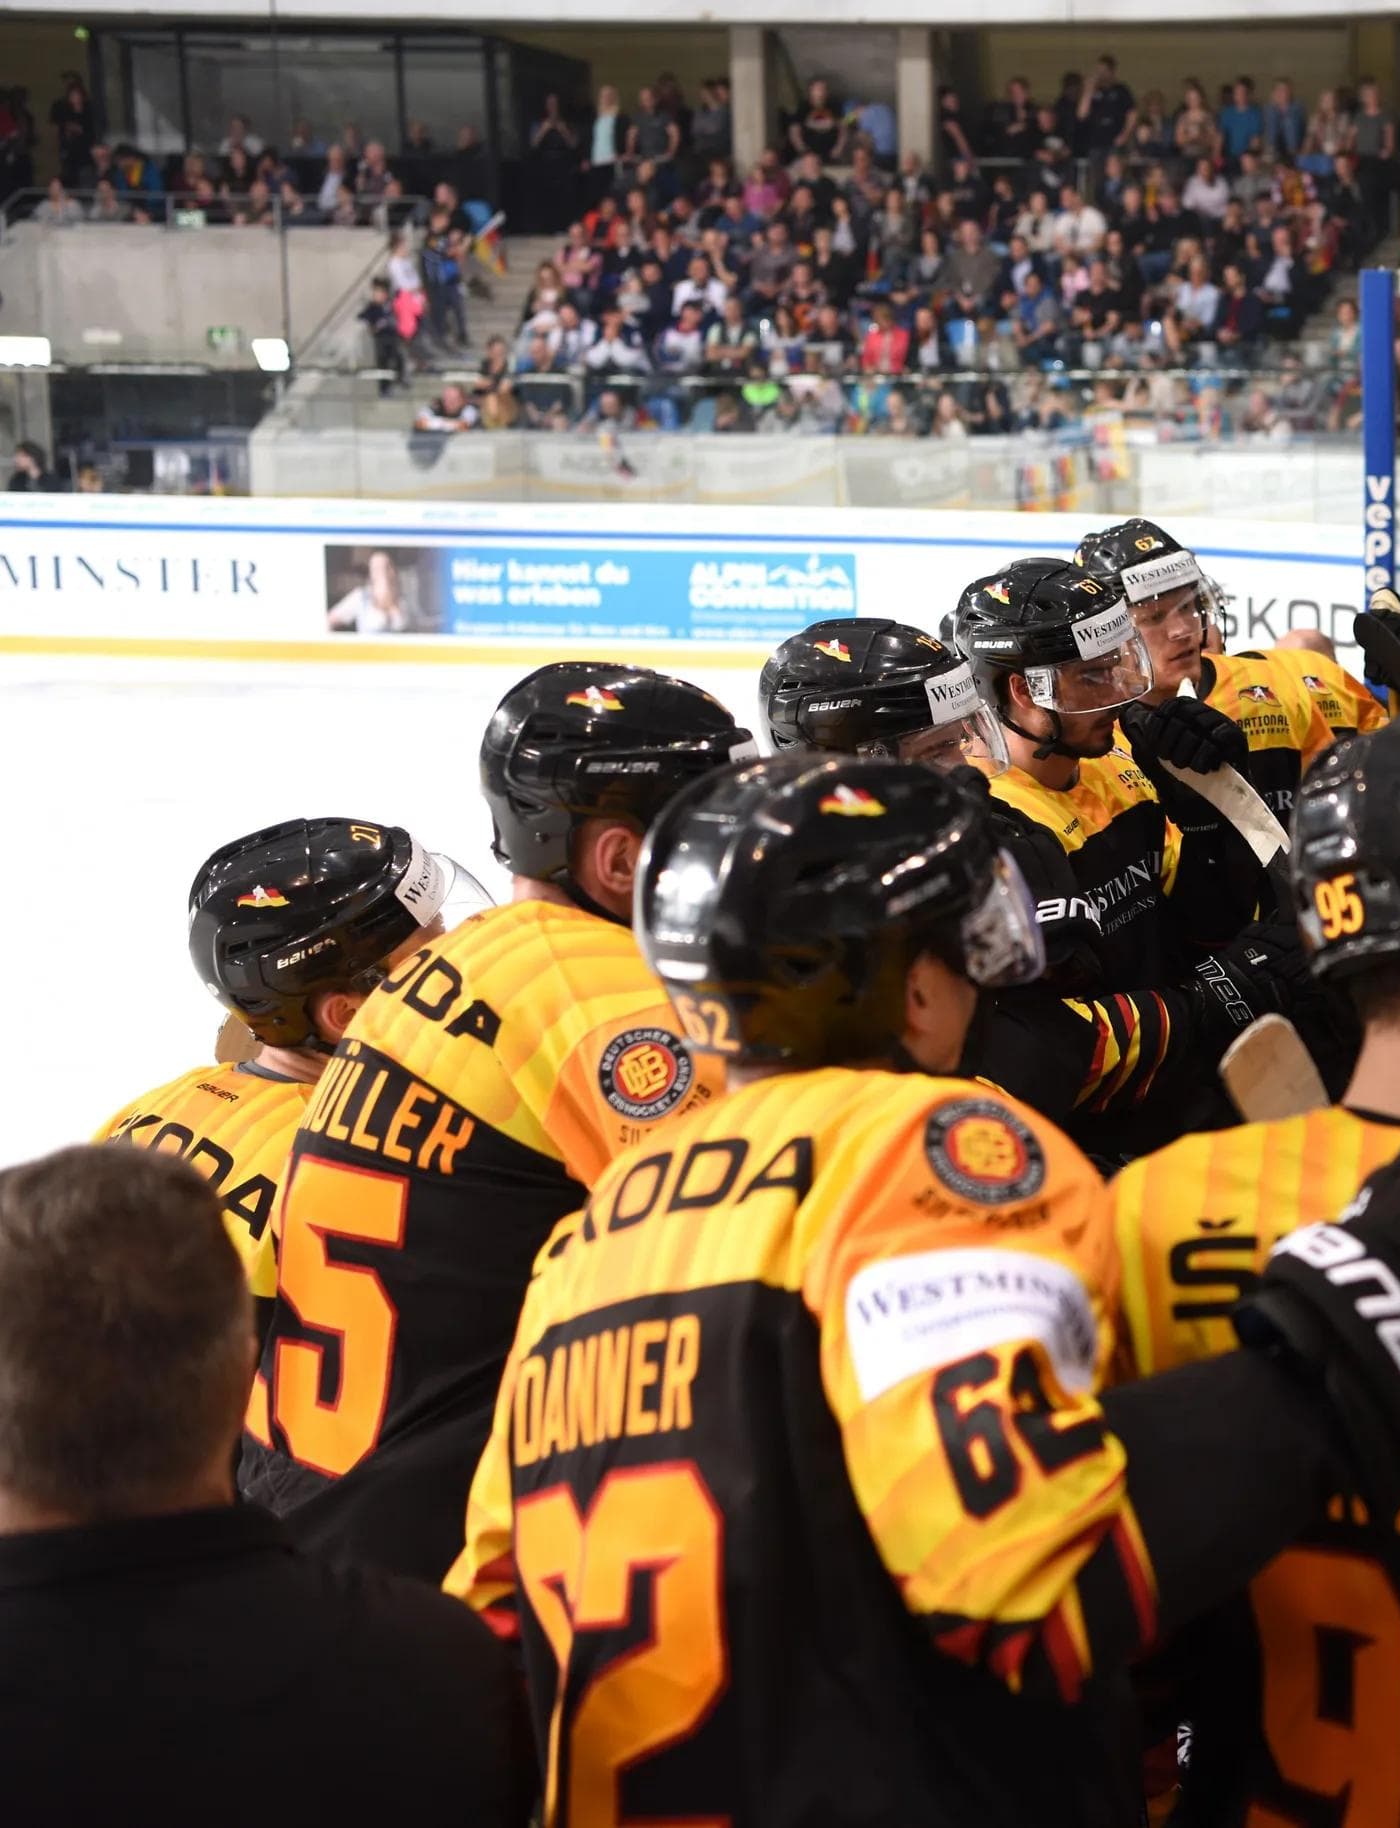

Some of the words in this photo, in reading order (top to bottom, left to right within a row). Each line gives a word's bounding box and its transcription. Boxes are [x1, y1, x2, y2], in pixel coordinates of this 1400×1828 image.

[807, 698, 863, 713] BAUER
[1314, 872, 1365, 939] 95
[514, 1312, 702, 1467] DANNER
